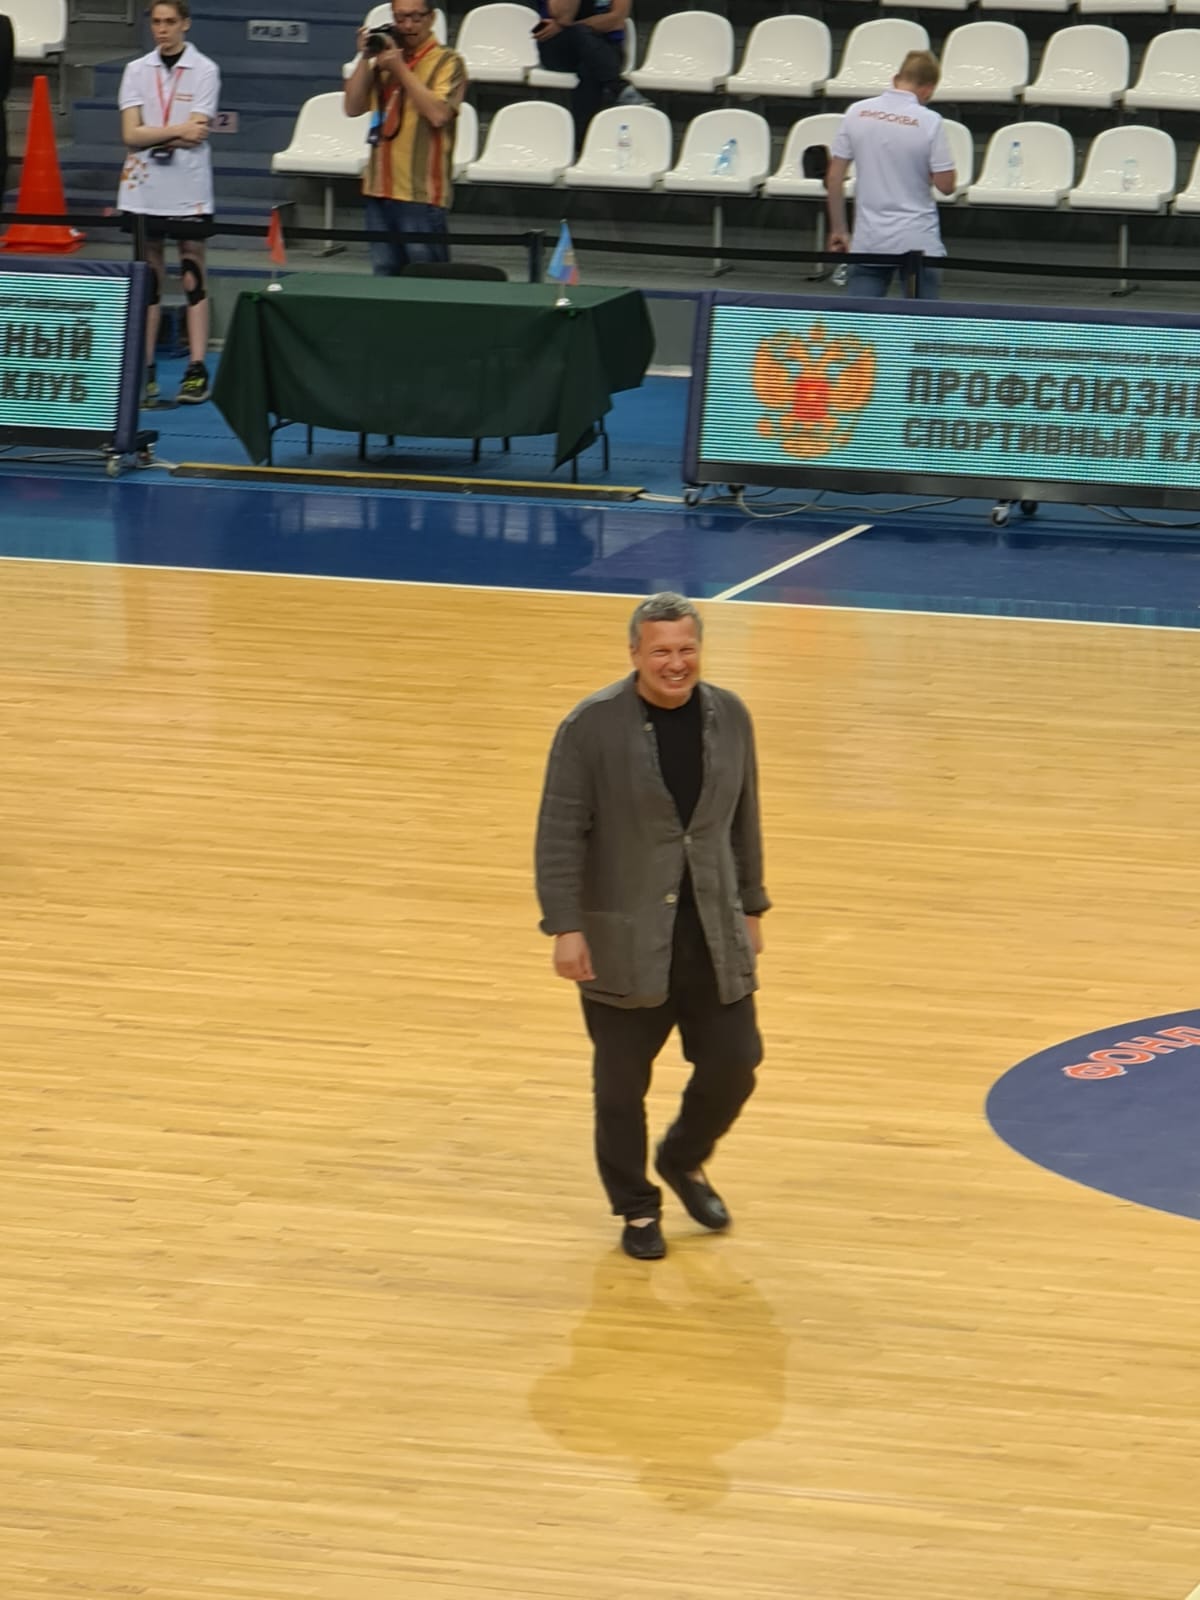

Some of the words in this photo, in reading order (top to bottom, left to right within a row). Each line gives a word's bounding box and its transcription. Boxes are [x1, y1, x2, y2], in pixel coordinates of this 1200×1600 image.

[288, 24, 301, 37] 3
[217, 113, 230, 127] 2
[4, 319, 93, 360] НЫЙ
[2, 369, 88, 403] КЛУБ
[906, 366, 1200, 420] ПРОФСОЮЗН
[903, 417, 1144, 459] СПОРТИВНЫЙ
